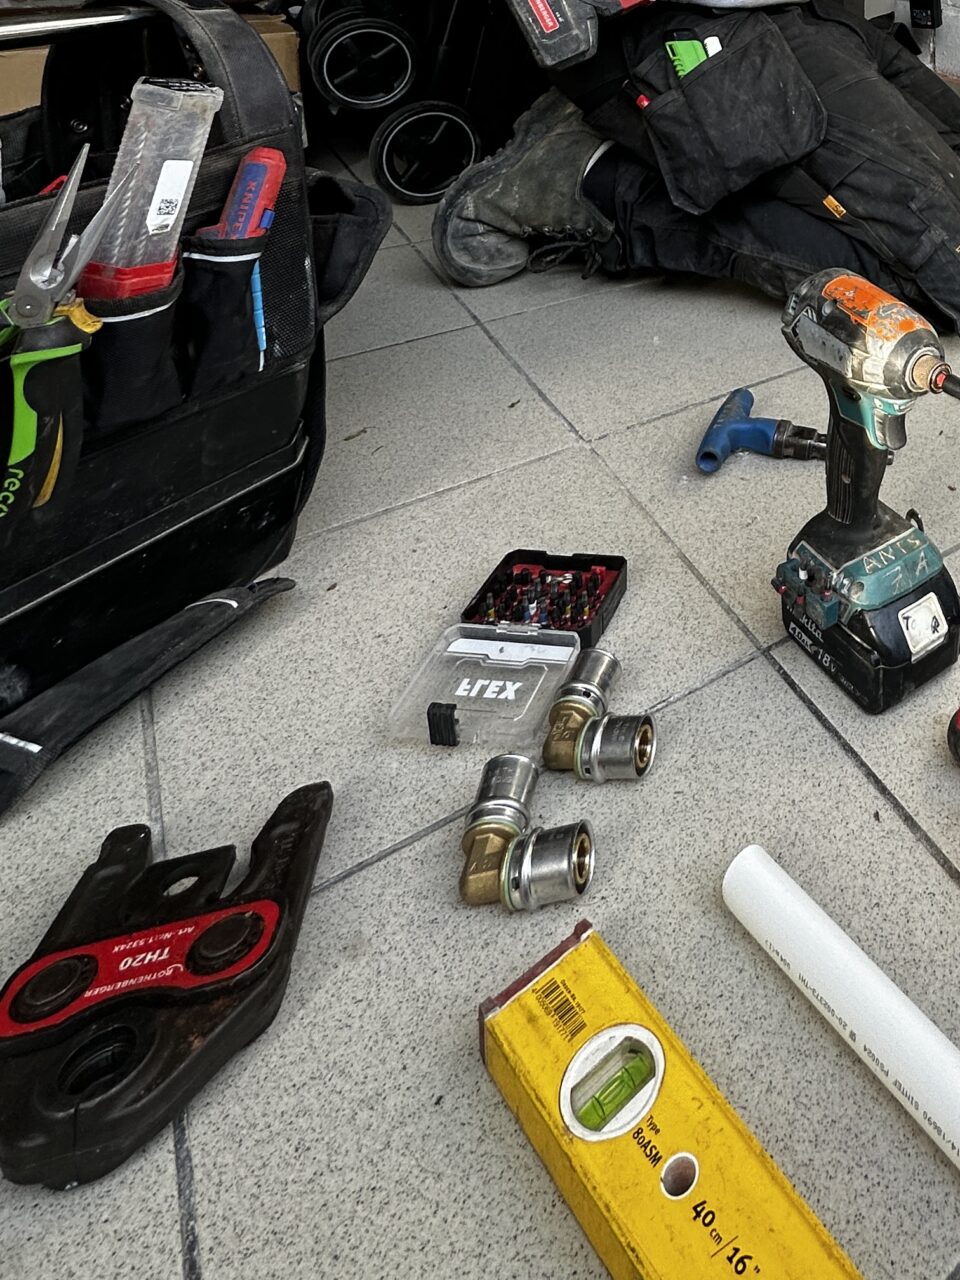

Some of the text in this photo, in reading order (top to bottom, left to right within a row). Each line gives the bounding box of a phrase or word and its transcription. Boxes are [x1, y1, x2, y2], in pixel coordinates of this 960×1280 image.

[118, 946, 171, 971] TH20
[83, 967, 174, 998] ROTHENBERGER
[646, 1114, 661, 1135] Type
[632, 1127, 663, 1168] 80ASM
[692, 1200, 716, 1228] 40
